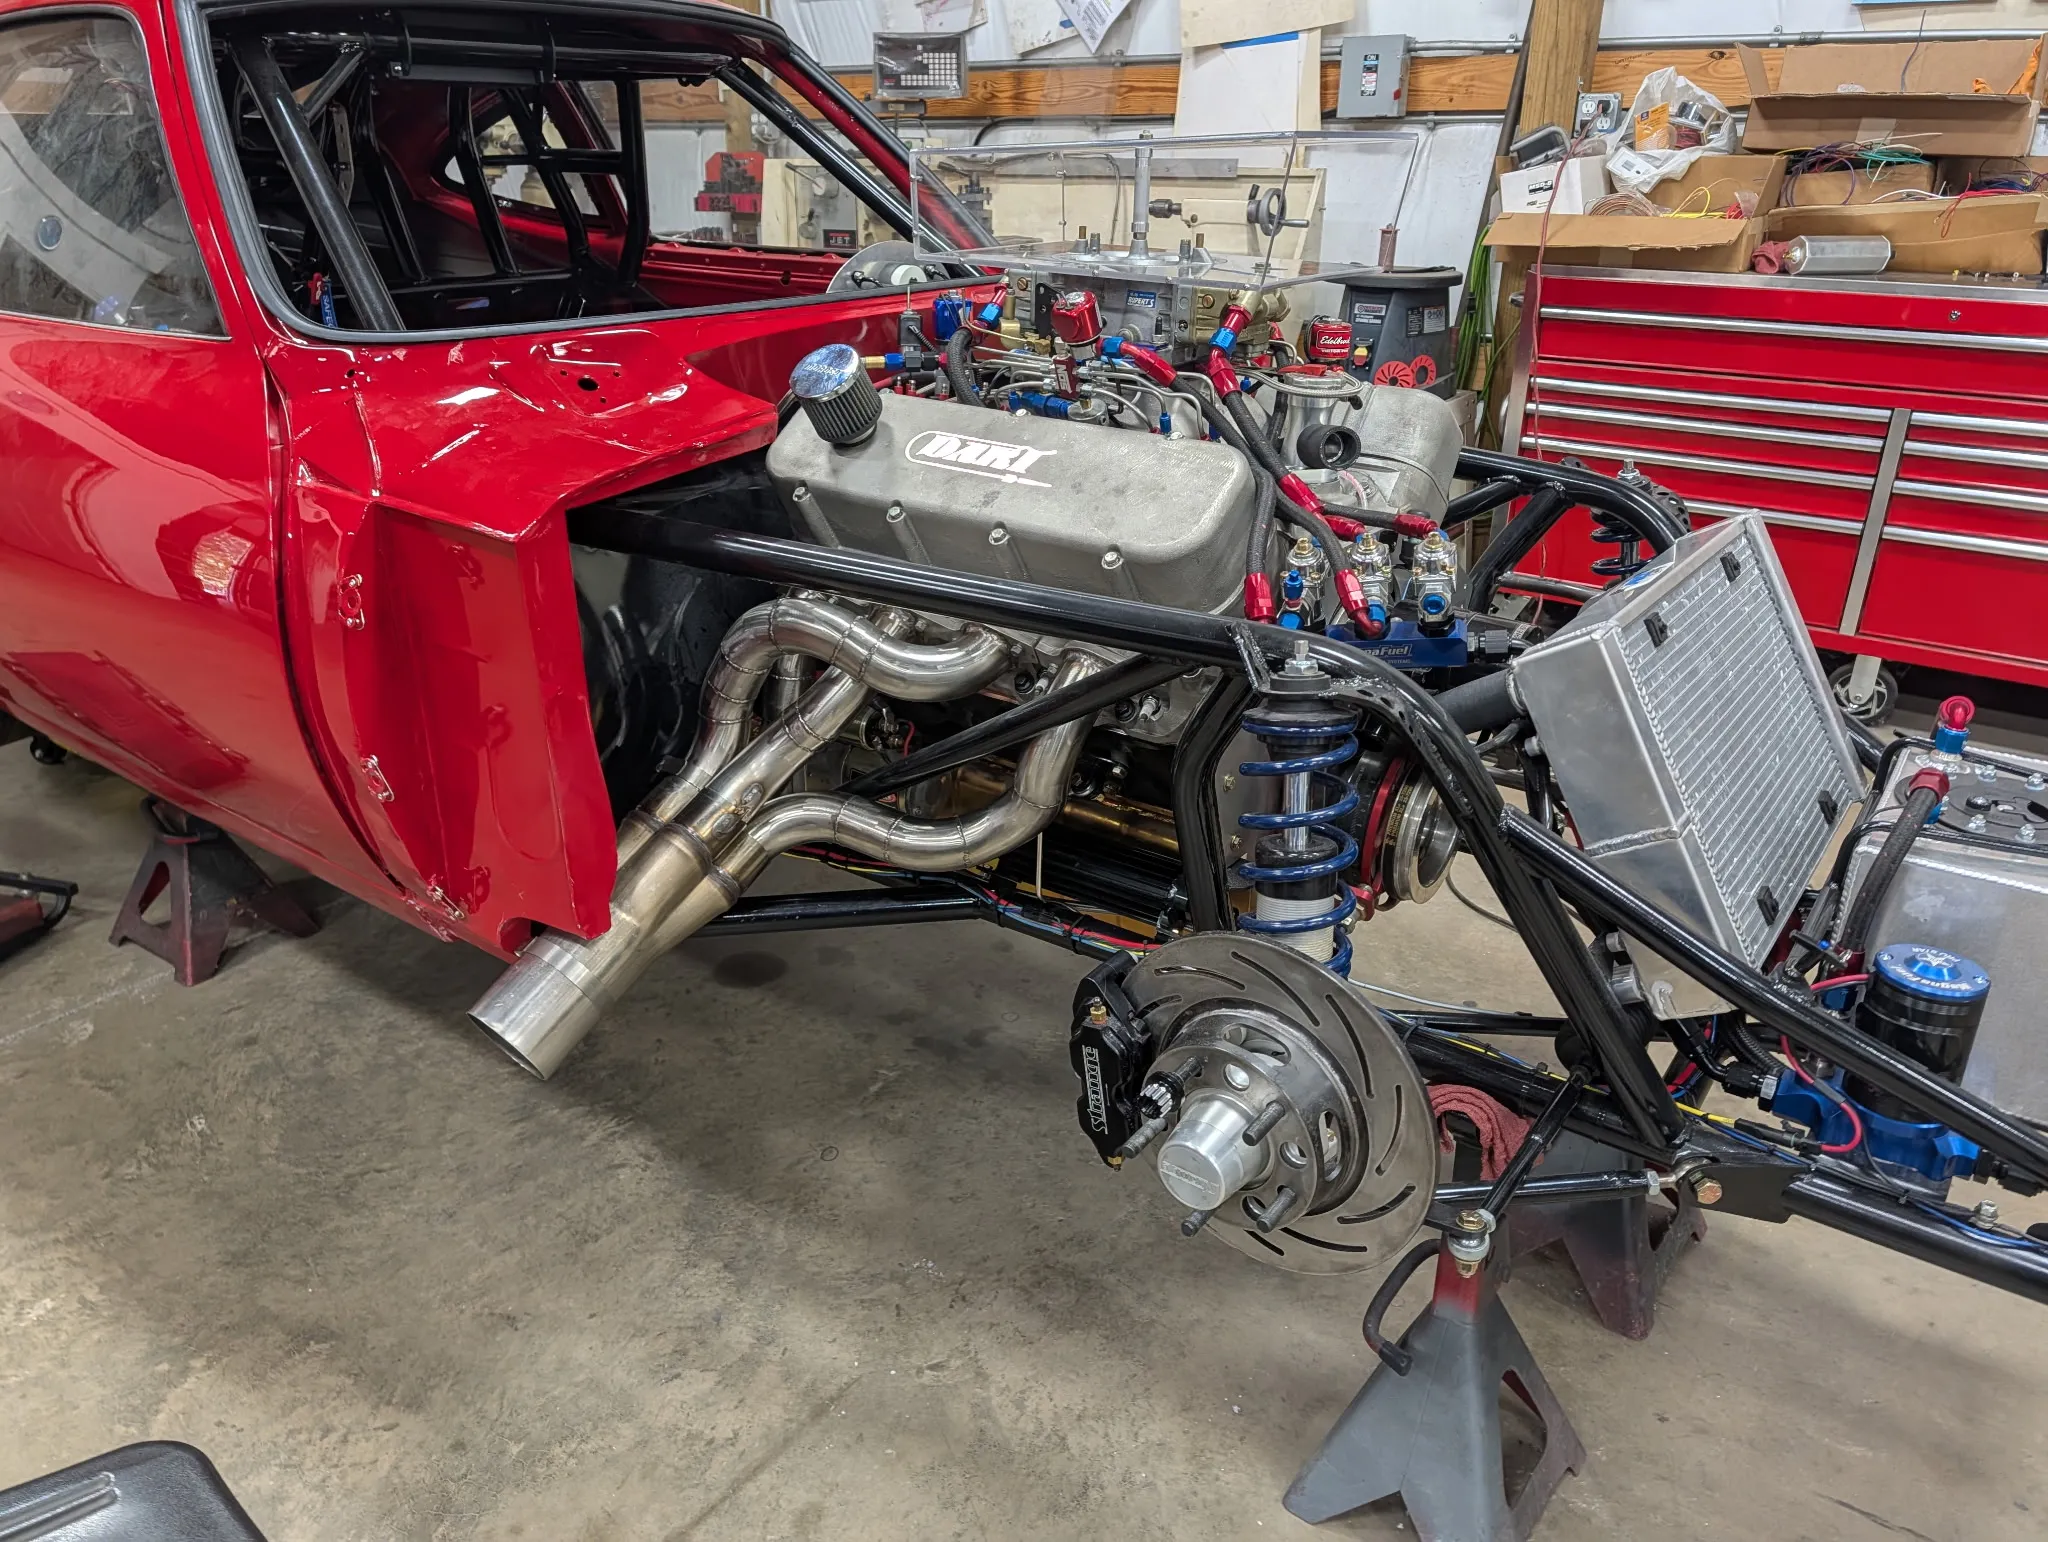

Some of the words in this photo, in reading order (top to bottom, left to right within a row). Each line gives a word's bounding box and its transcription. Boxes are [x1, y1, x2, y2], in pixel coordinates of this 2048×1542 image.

[829, 236, 850, 244] JET
[915, 433, 1057, 475] DART
[1364, 645, 1410, 657] naFuel
